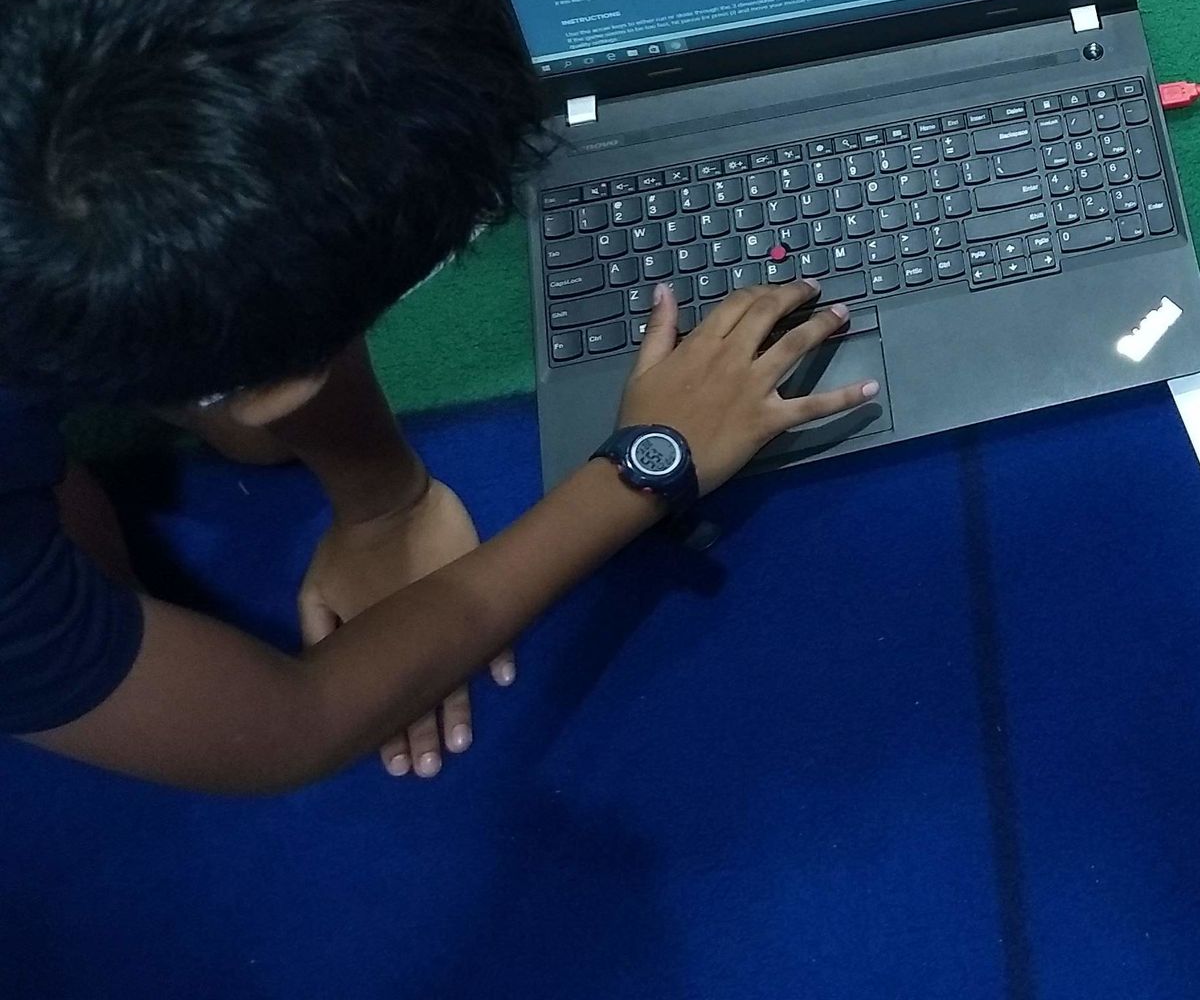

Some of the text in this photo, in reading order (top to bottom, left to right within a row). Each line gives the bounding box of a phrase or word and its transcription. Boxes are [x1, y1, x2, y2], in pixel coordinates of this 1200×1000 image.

[561, 11, 621, 25] INSTRUCTIONS
[1104, 136, 1110, 145] 9
[1075, 142, 1082, 150] 8
[1046, 147, 1052, 156] 7
[1110, 164, 1116, 172] 6
[1080, 170, 1088, 178] 5
[901, 176, 908, 185] P
[1052, 175, 1059, 183] 4
[784, 180, 791, 188] 7
[868, 182, 878, 192] O
[751, 186, 758, 194] 6
[803, 196, 811, 204] U
[1115, 191, 1122, 200] 3
[1086, 197, 1094, 206] 2
[770, 202, 778, 211] Y
[1057, 203, 1063, 212] 1
[615, 213, 622, 221] 2
[736, 209, 744, 217] T
[881, 210, 888, 218] L
[702, 216, 712, 224] R
[848, 217, 857, 225] K
[668, 222, 676, 231] E
[815, 223, 822, 232] J
[634, 228, 646, 237] W
[782, 230, 791, 238] H
[1062, 232, 1070, 241] 0
[600, 236, 610, 245] Q
[748, 236, 758, 246] G
[714, 243, 721, 252] F
[679, 250, 688, 259] D
[835, 248, 845, 258] M
[645, 257, 654, 265] S
[802, 255, 811, 264] N
[611, 264, 620, 273] A
[769, 266, 777, 275] B
[734, 270, 743, 278] V
[550, 277, 582, 288] CapsLock
[700, 276, 709, 285] C
[630, 291, 639, 299] Z
